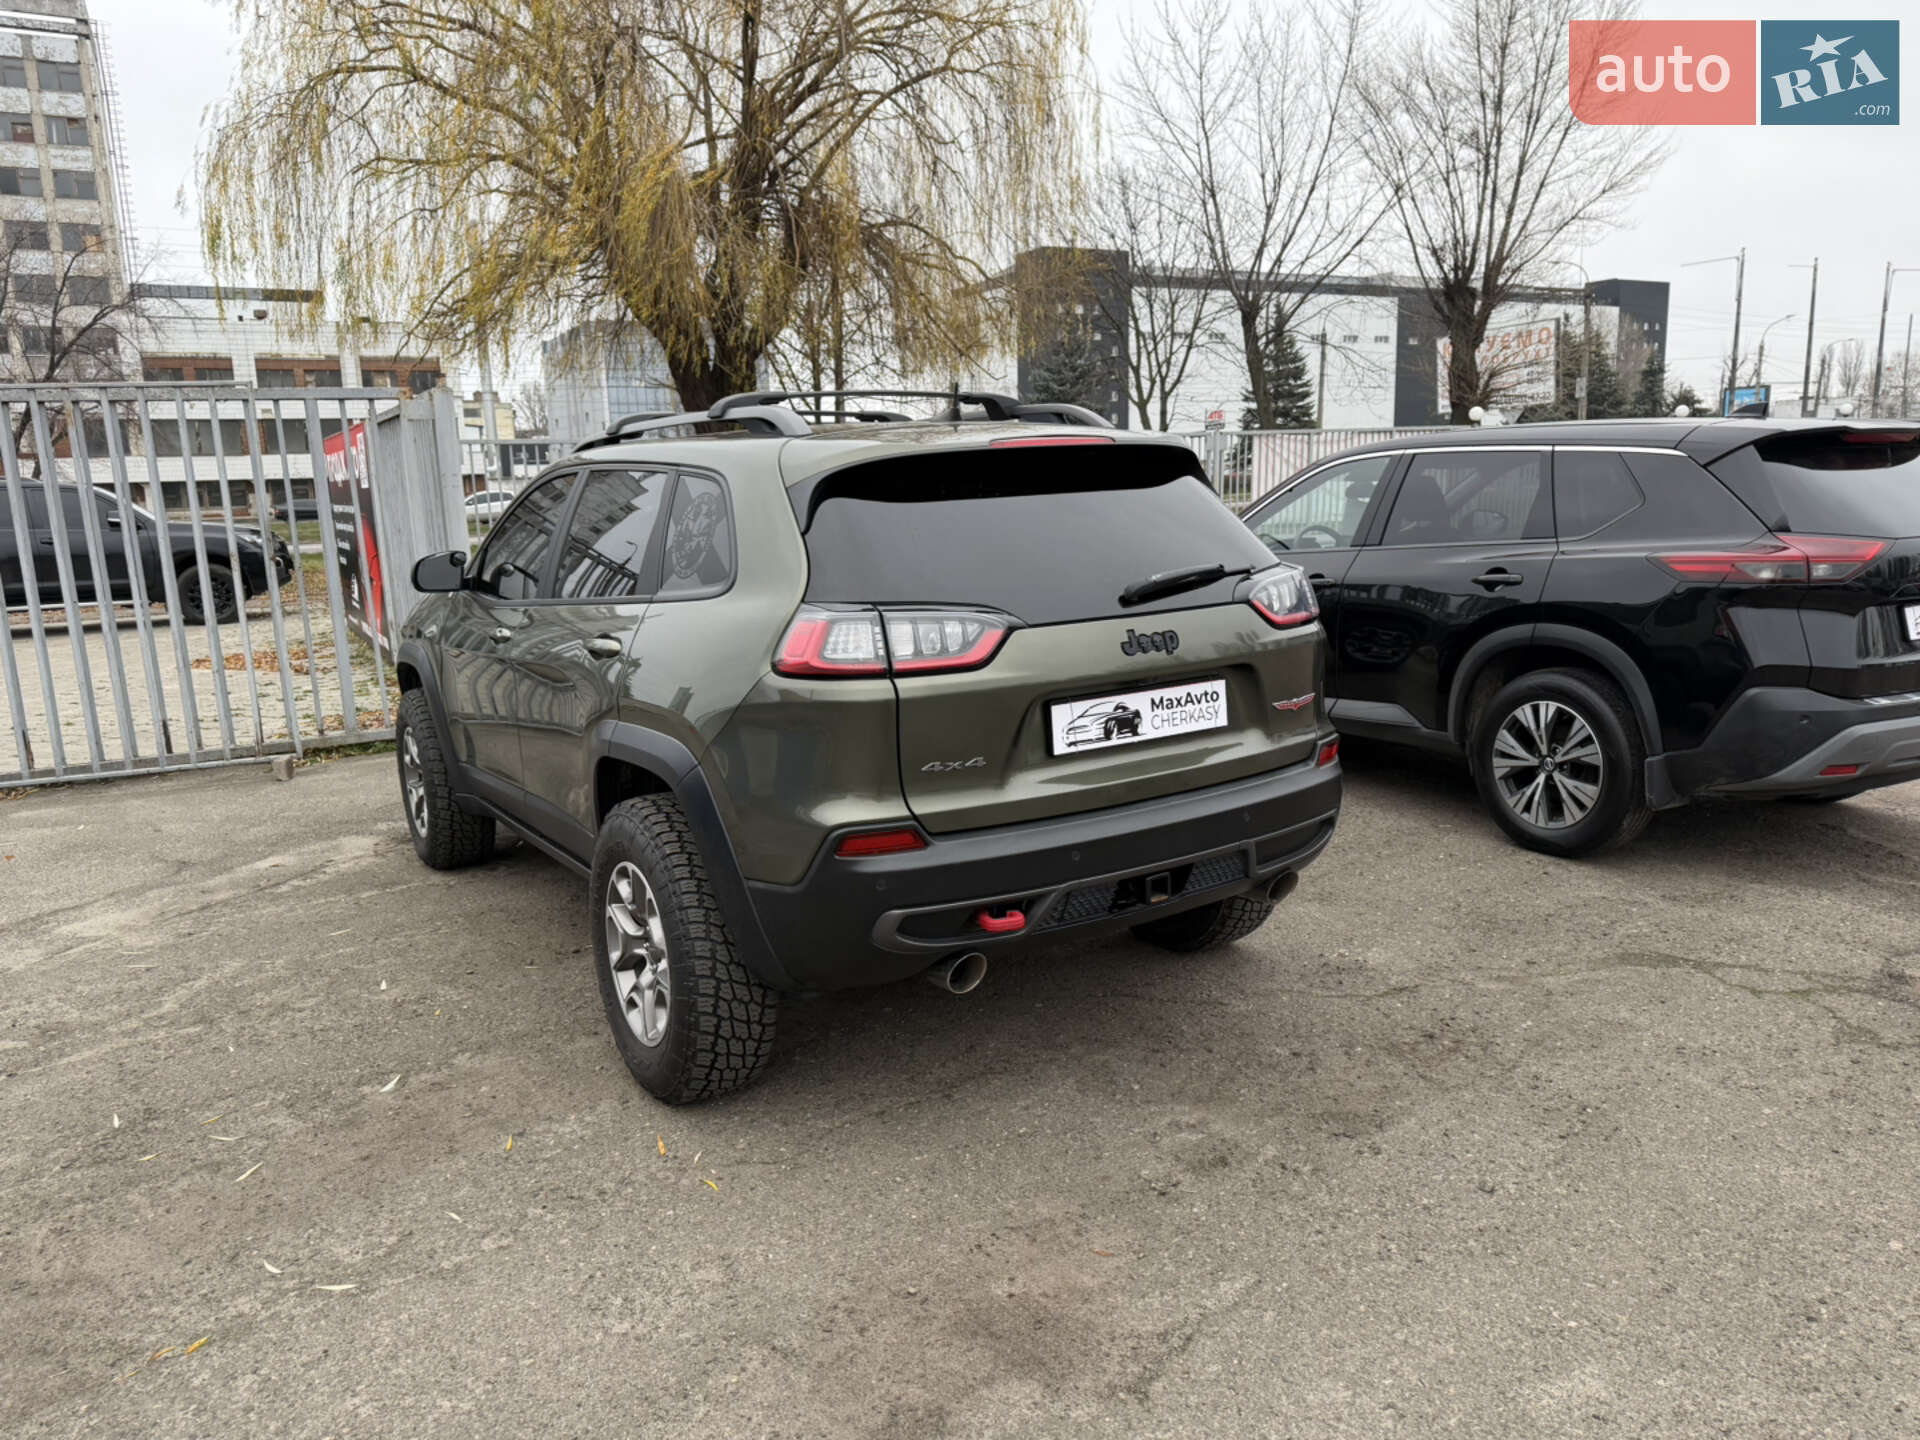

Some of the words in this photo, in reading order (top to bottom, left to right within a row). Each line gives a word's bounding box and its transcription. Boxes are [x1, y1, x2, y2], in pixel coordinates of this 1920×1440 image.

[1120, 628, 1179, 656] Jeep
[1150, 689, 1220, 712] MaxAvto
[1151, 704, 1221, 730] CHERKASY
